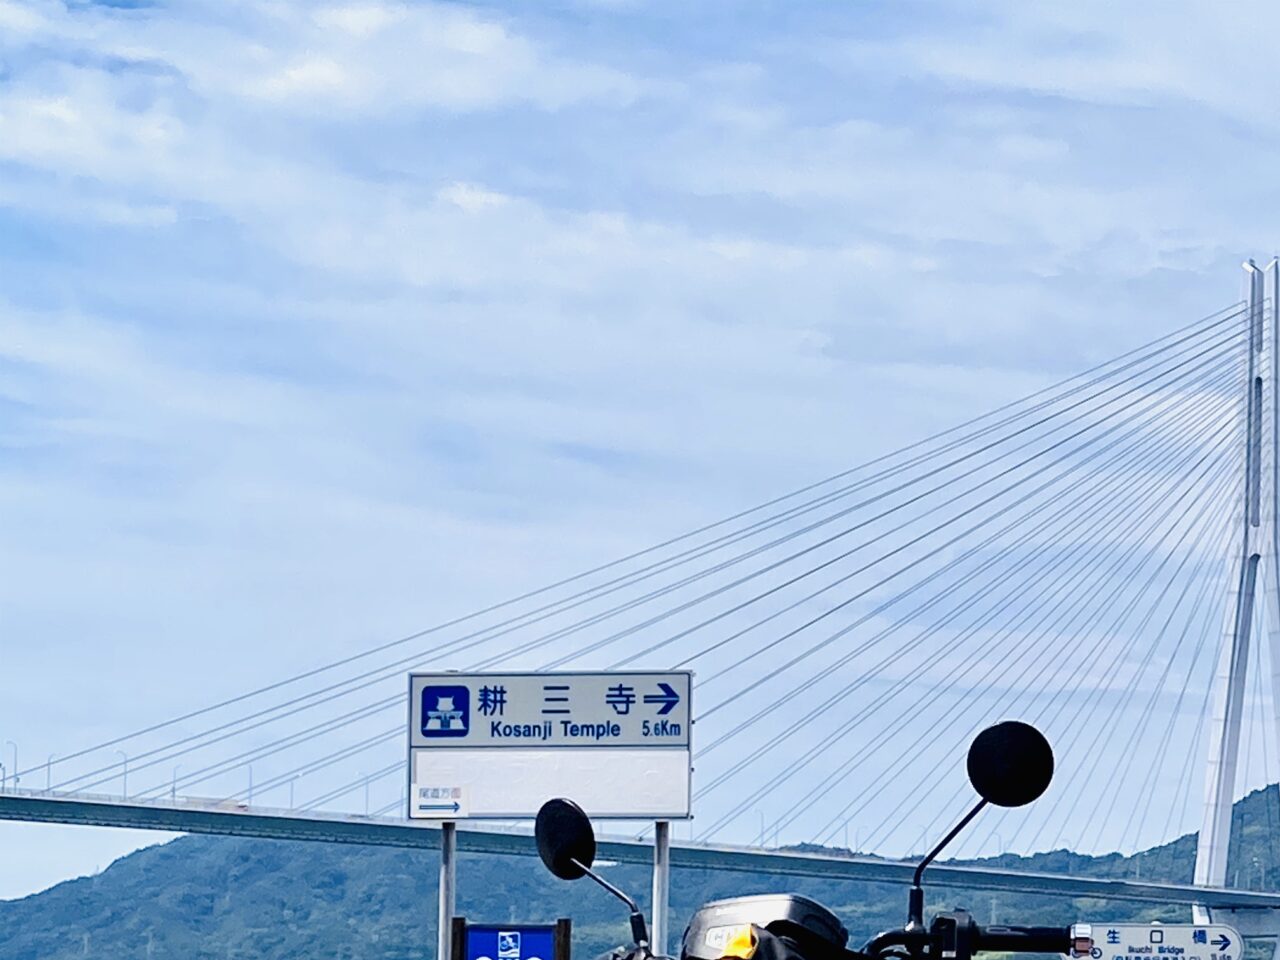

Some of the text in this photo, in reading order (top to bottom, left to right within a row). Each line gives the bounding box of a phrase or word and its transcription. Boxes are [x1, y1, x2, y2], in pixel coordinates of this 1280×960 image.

[478, 684, 636, 716] 耕三寺
[491, 719, 681, 740] Kosanji Temple 5.6Km
[1158, 946, 1185, 955] Bridge
